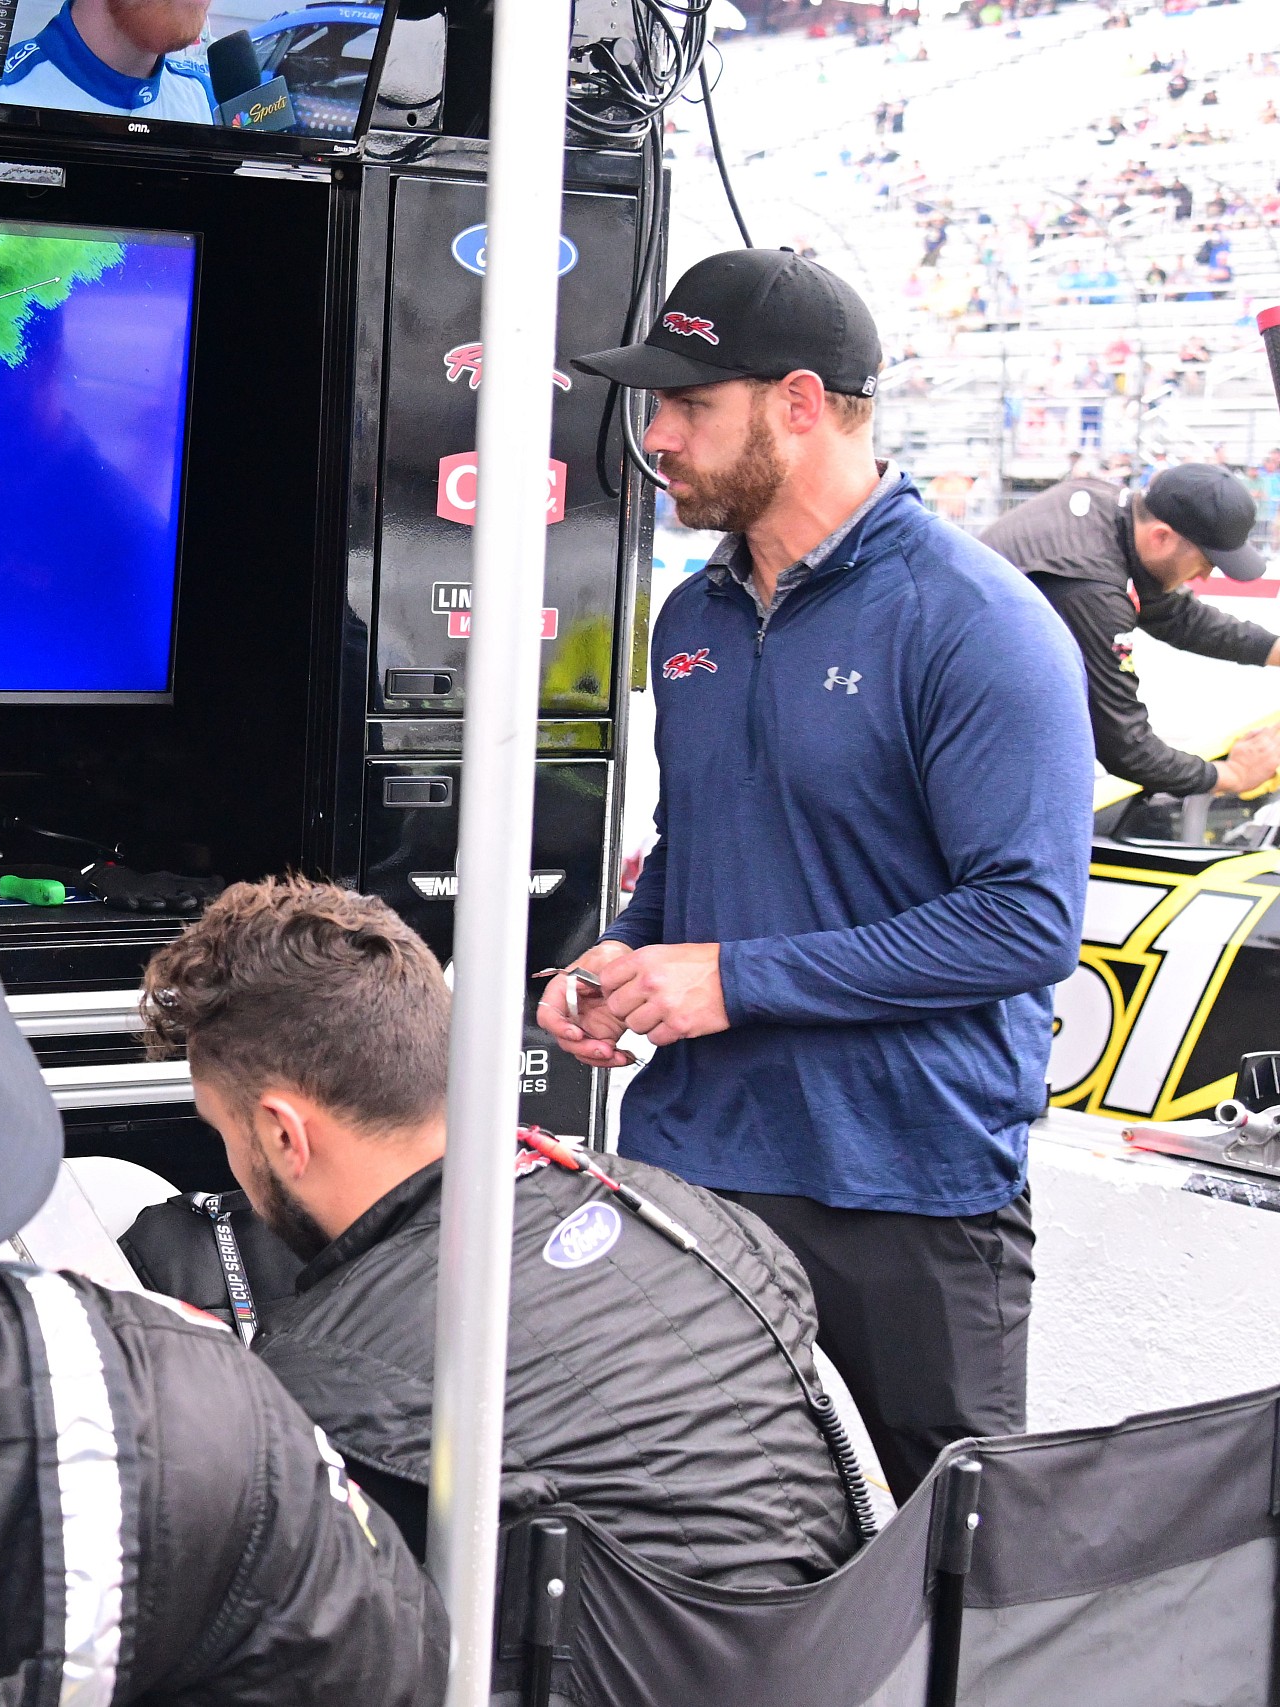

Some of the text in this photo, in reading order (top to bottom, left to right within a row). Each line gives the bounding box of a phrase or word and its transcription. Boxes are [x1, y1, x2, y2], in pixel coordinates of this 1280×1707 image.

[249, 95, 288, 123] Sports
[1051, 878, 1258, 1116] 51
[217, 1224, 247, 1300] CUP SERIES
